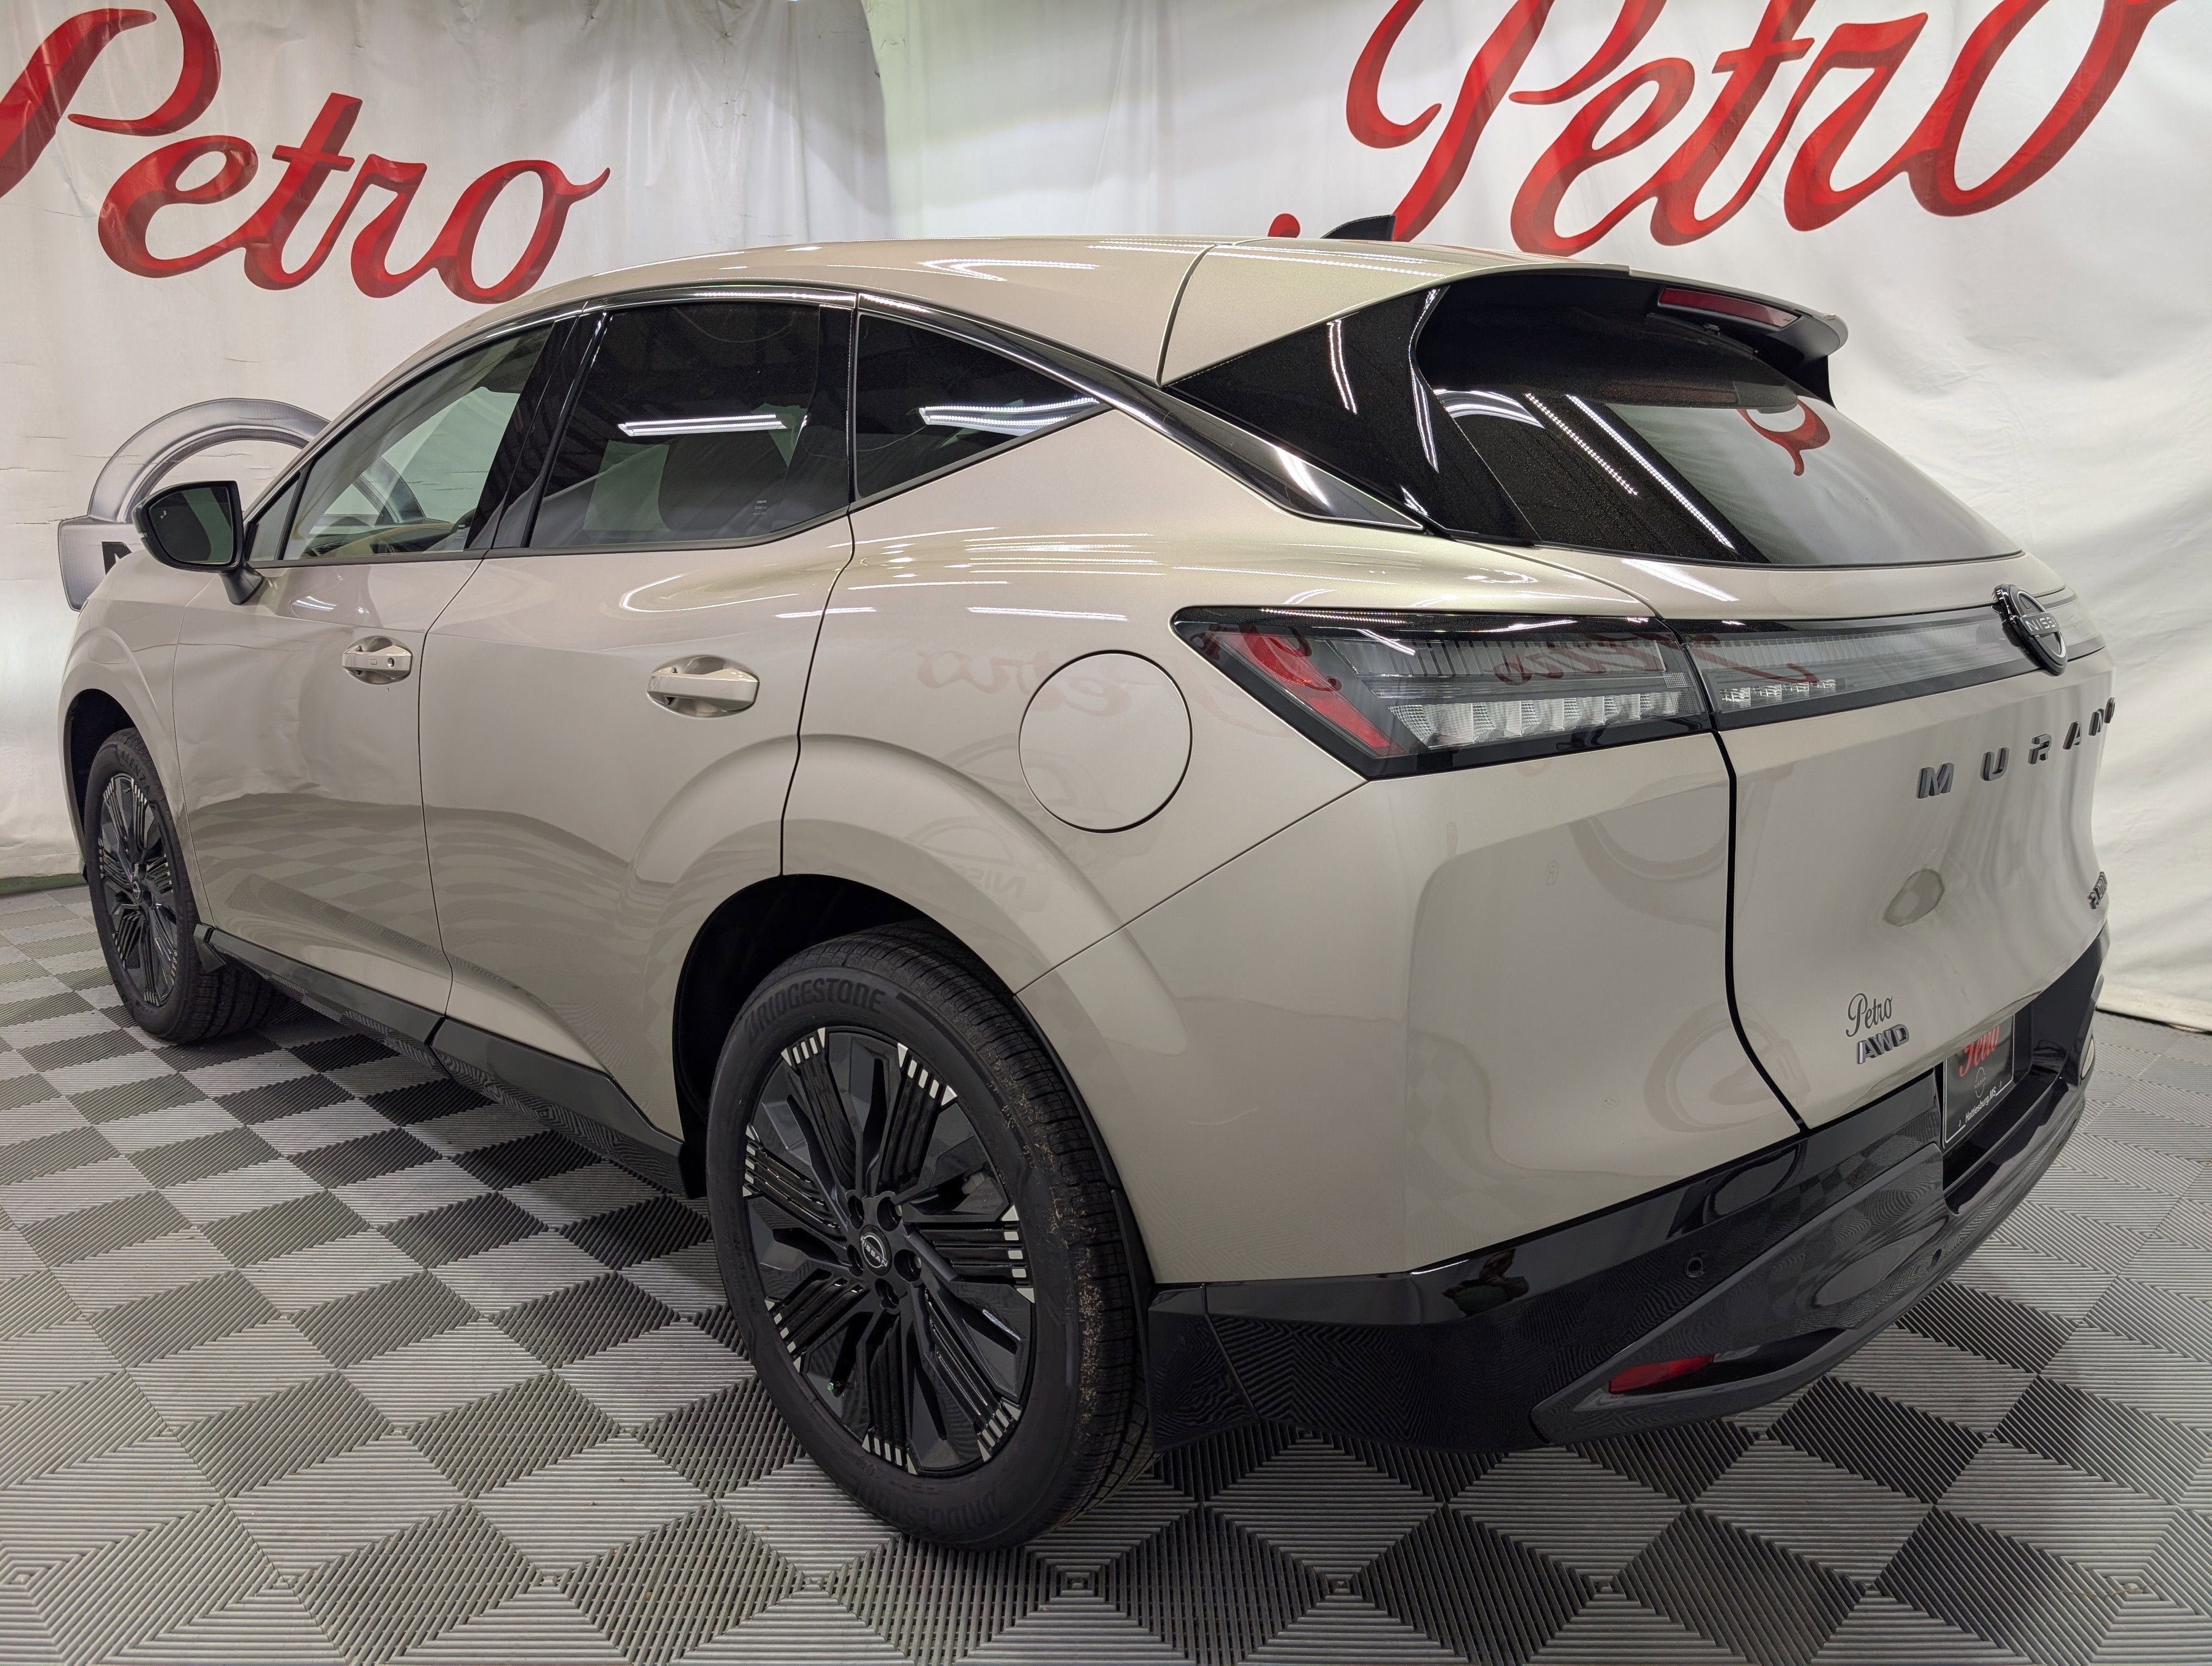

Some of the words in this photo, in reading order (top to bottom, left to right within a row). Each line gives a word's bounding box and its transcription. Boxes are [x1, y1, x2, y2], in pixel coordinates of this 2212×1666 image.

[1268, 0, 2168, 257] Petro
[0, 0, 610, 304] Petro
[1846, 993, 1893, 1037] Petro
[1856, 1024, 1909, 1064] AWD
[860, 1235, 888, 1267] NISSAN
